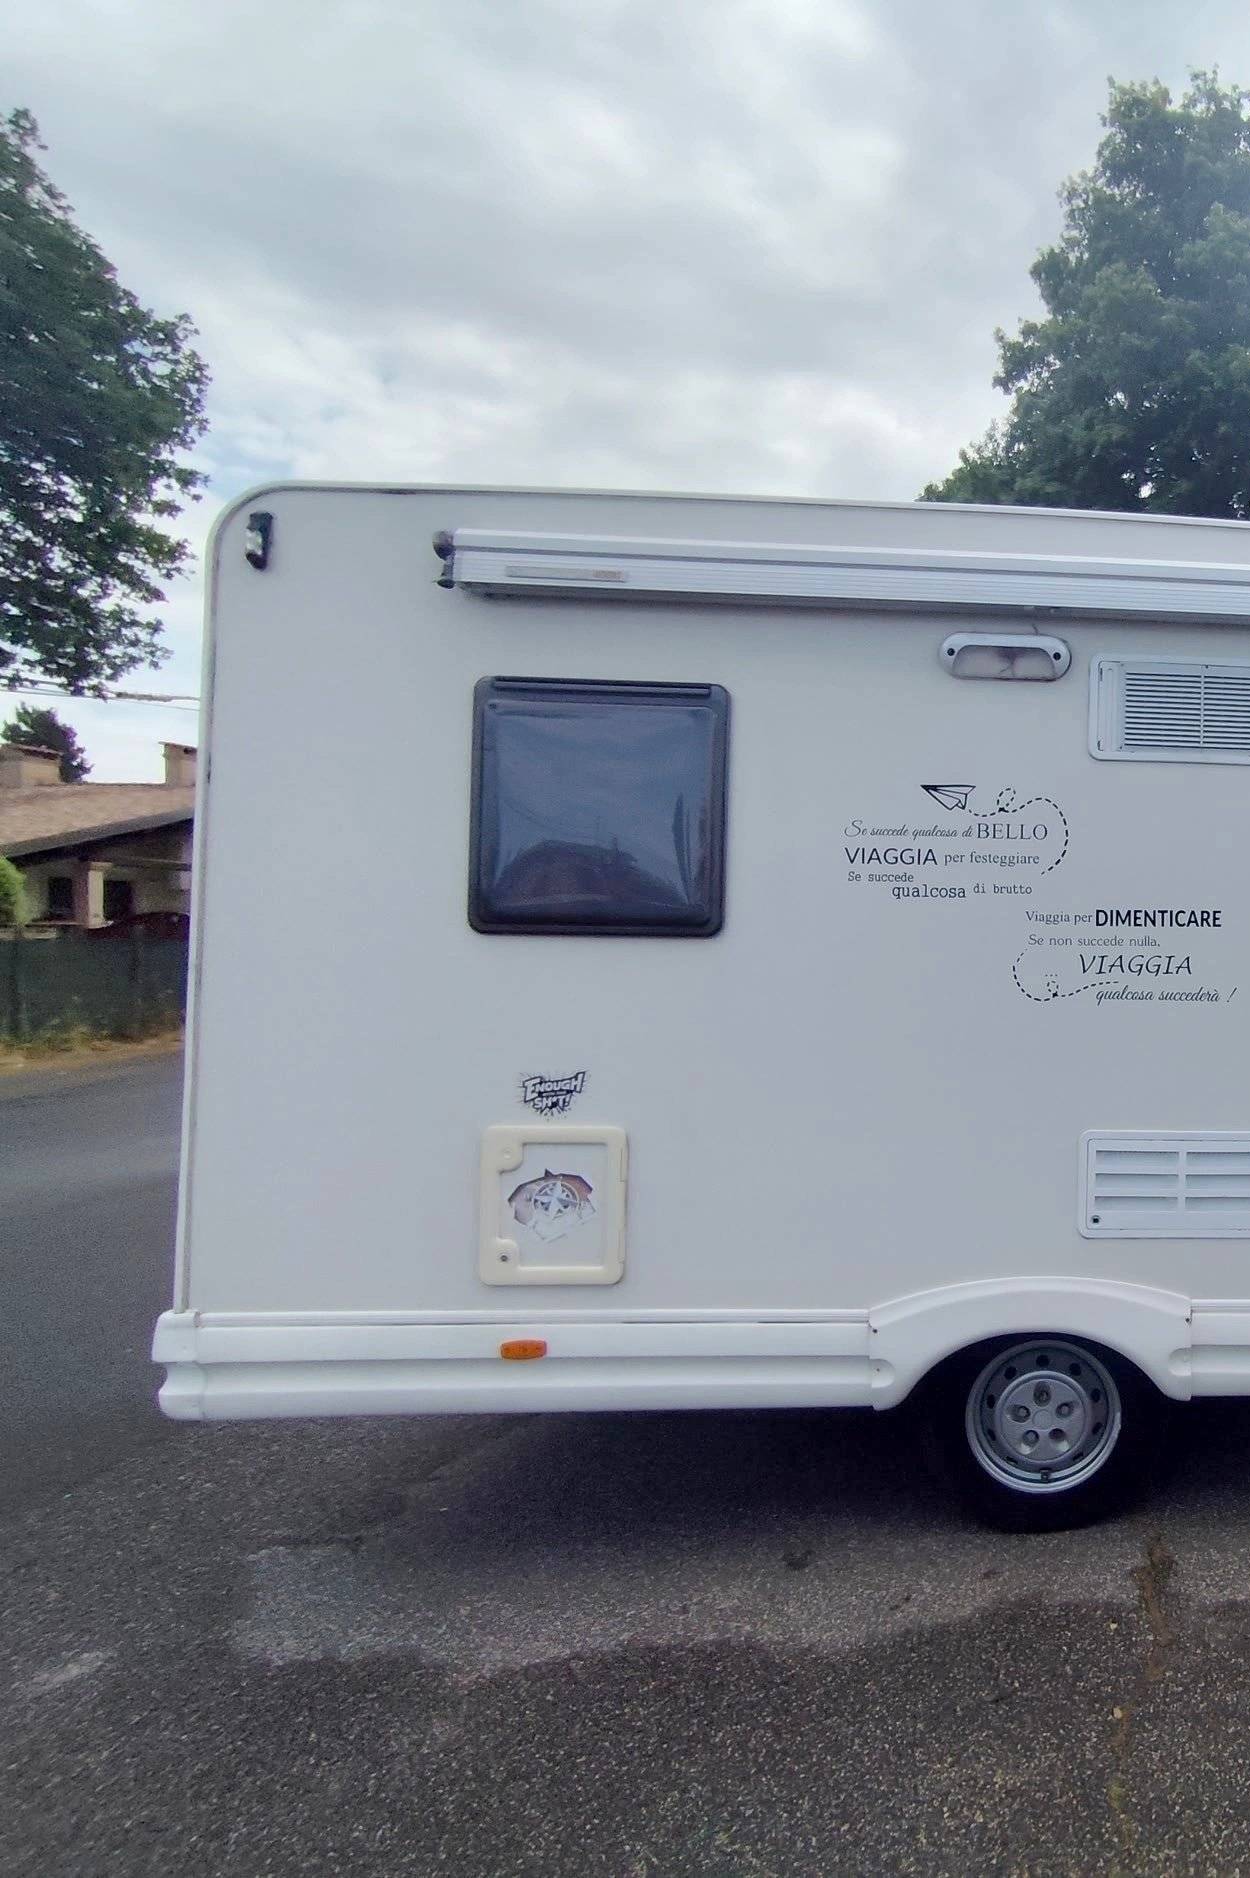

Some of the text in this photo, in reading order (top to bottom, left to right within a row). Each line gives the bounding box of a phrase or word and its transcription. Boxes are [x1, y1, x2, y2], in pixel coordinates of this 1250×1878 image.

[844, 819, 1049, 840] Se succede qualcosa di BELLO
[844, 847, 1040, 867] VIAGGIA per festeggiare
[847, 871, 914, 883] Se succede
[891, 883, 1033, 900] qualcosa di brutto
[1025, 909, 1222, 928] Viaggia per DIMENTICARE
[1027, 934, 1044, 946] Se
[1048, 936, 1073, 946] non
[1077, 935, 1124, 947] succede
[1078, 953, 1193, 977] VIAGGIA
[1095, 984, 1155, 1006] qualcosa
[1157, 986, 1221, 1003] succederà
[523, 1071, 586, 1103] ENOUGH
